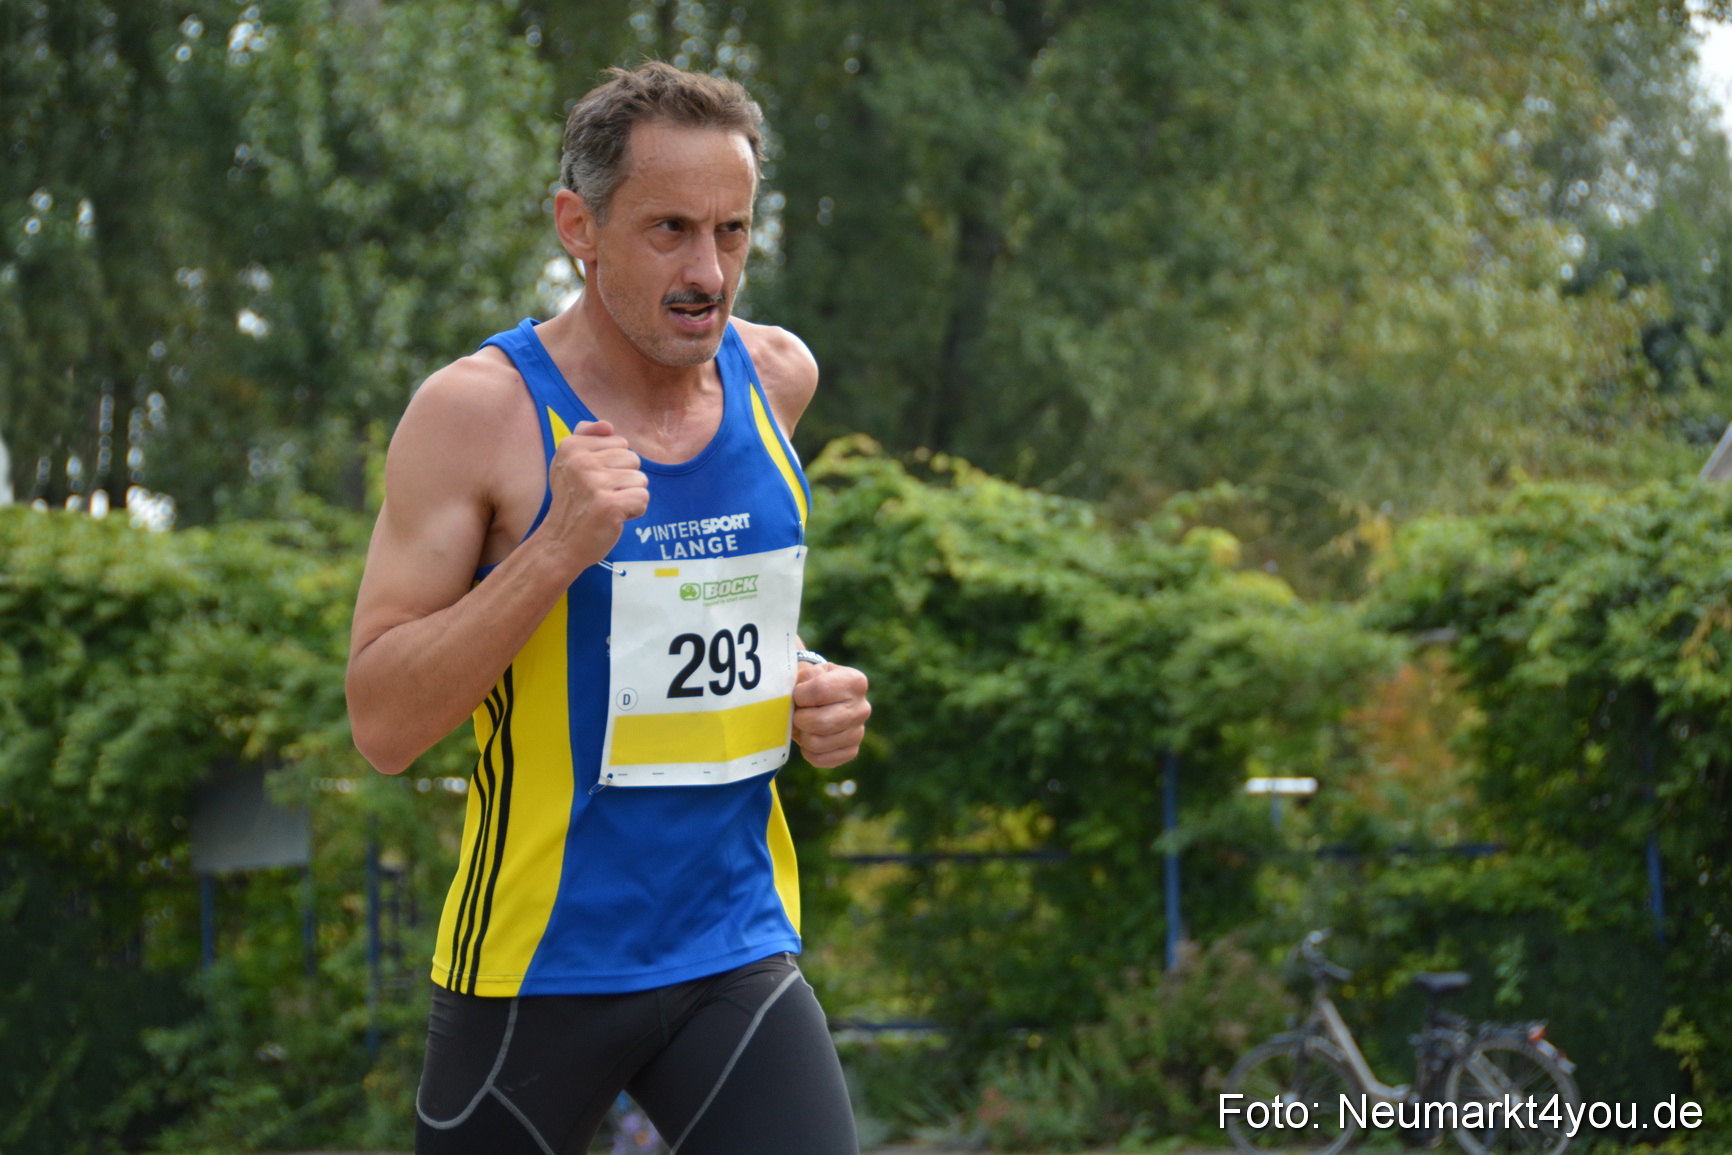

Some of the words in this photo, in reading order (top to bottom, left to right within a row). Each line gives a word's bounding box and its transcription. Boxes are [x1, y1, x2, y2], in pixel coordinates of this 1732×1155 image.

[653, 513, 750, 541] INTERSPORT
[660, 534, 738, 560] LANGE
[703, 575, 759, 600] BOCK
[666, 623, 761, 698] 293
[622, 693, 632, 706] D
